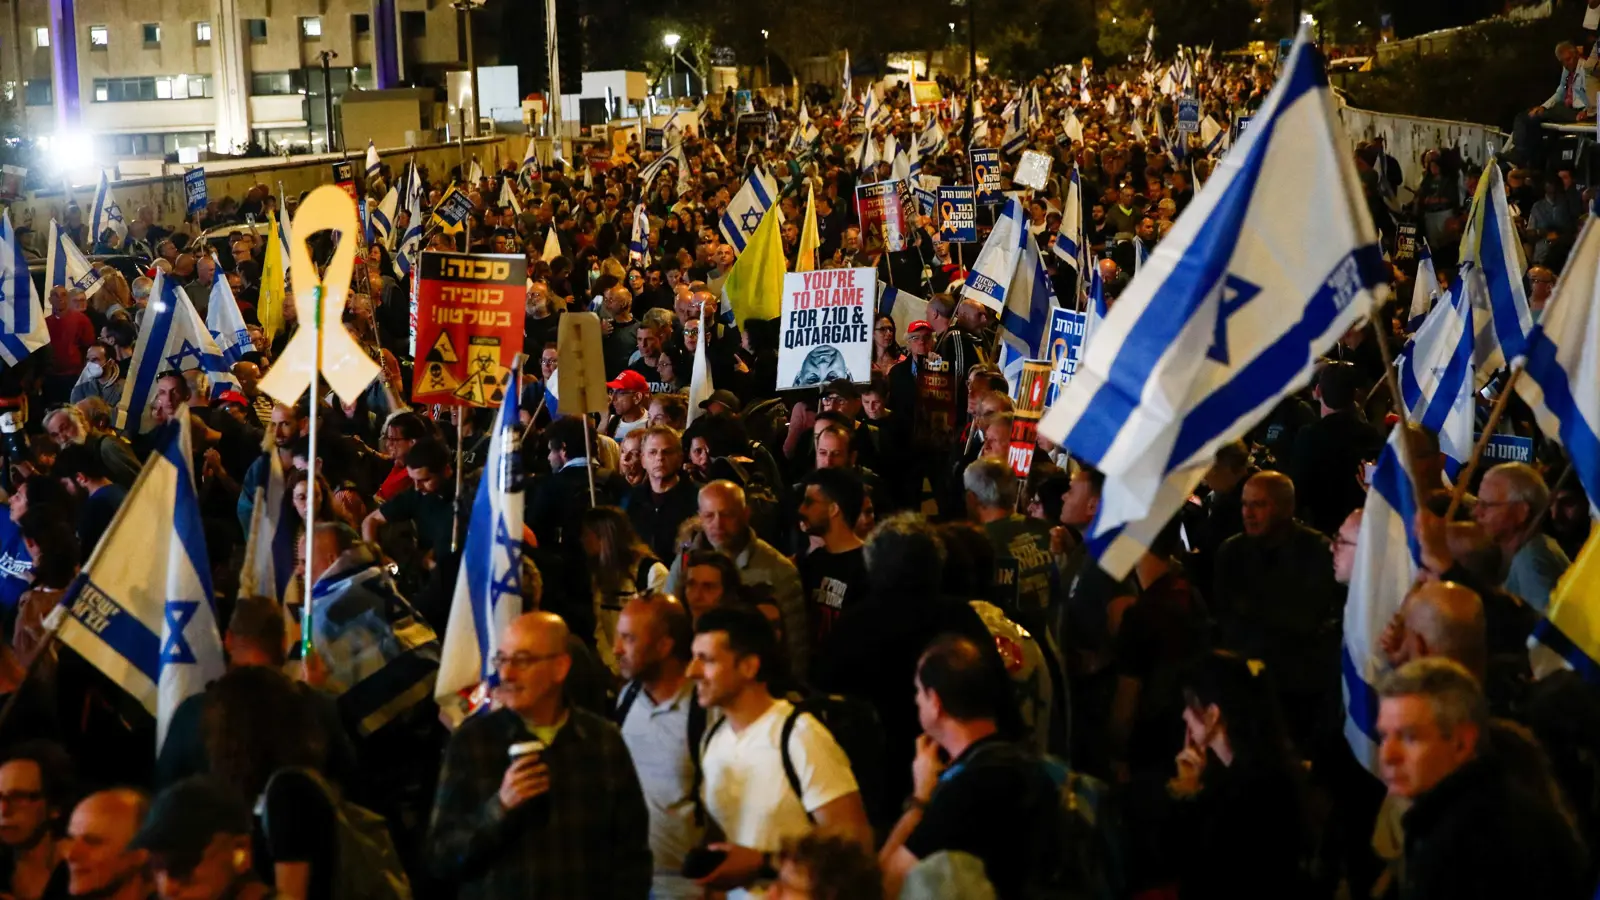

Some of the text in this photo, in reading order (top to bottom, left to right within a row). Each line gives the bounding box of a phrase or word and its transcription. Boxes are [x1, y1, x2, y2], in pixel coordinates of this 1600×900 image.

[940, 190, 973, 199] אנחנו הרוב
[950, 211, 974, 221] עסקת
[956, 203, 973, 212] בעד
[943, 220, 974, 229] חטופים
[440, 258, 510, 280] סכנה!
[803, 270, 855, 290] YOU'RE
[441, 286, 504, 304] כנופיה
[792, 288, 864, 310] TO BLAME
[432, 305, 511, 327] בשלטון!
[790, 306, 864, 329] FOR 7.10 &
[1055, 318, 1073, 334] הרוב
[785, 324, 868, 349] QATARGATE
[1498, 444, 1528, 461] אנחנו
